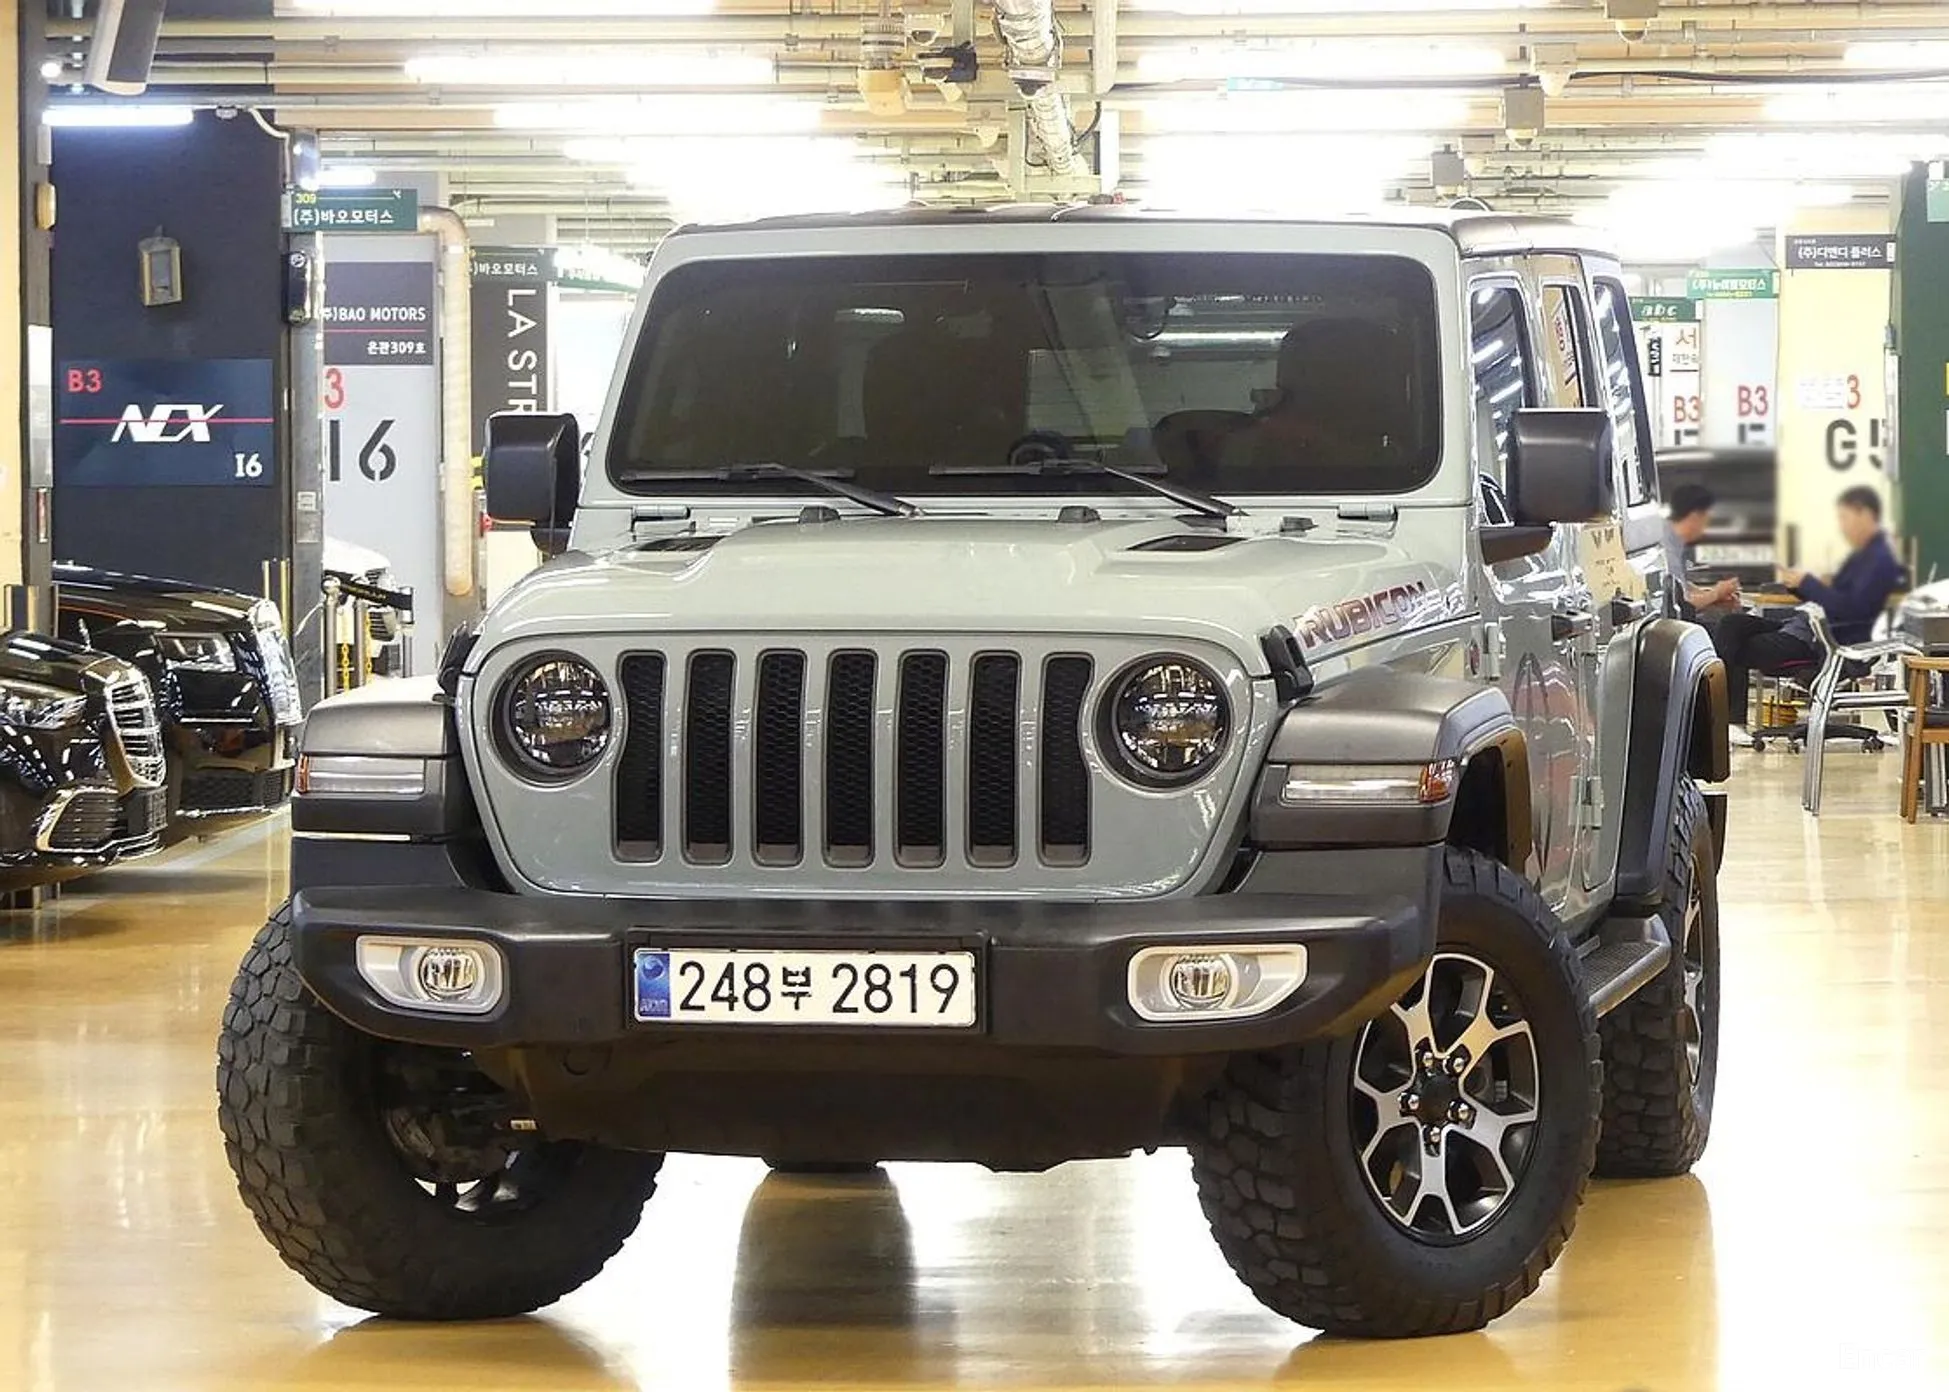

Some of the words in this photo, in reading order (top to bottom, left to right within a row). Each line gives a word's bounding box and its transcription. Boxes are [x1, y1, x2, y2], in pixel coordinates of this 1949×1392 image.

[293, 208, 394, 225] (주)바오모터스
[370, 307, 426, 321] MOTORS
[508, 289, 538, 338] LA
[1642, 304, 1677, 317] abc
[68, 369, 102, 393] B3
[1674, 396, 1700, 423] B3
[1738, 385, 1768, 417] B3
[111, 404, 224, 442] NEX
[1294, 581, 1426, 649] RUBICON
[679, 960, 812, 1012] 248부
[831, 962, 960, 1014] 2819
